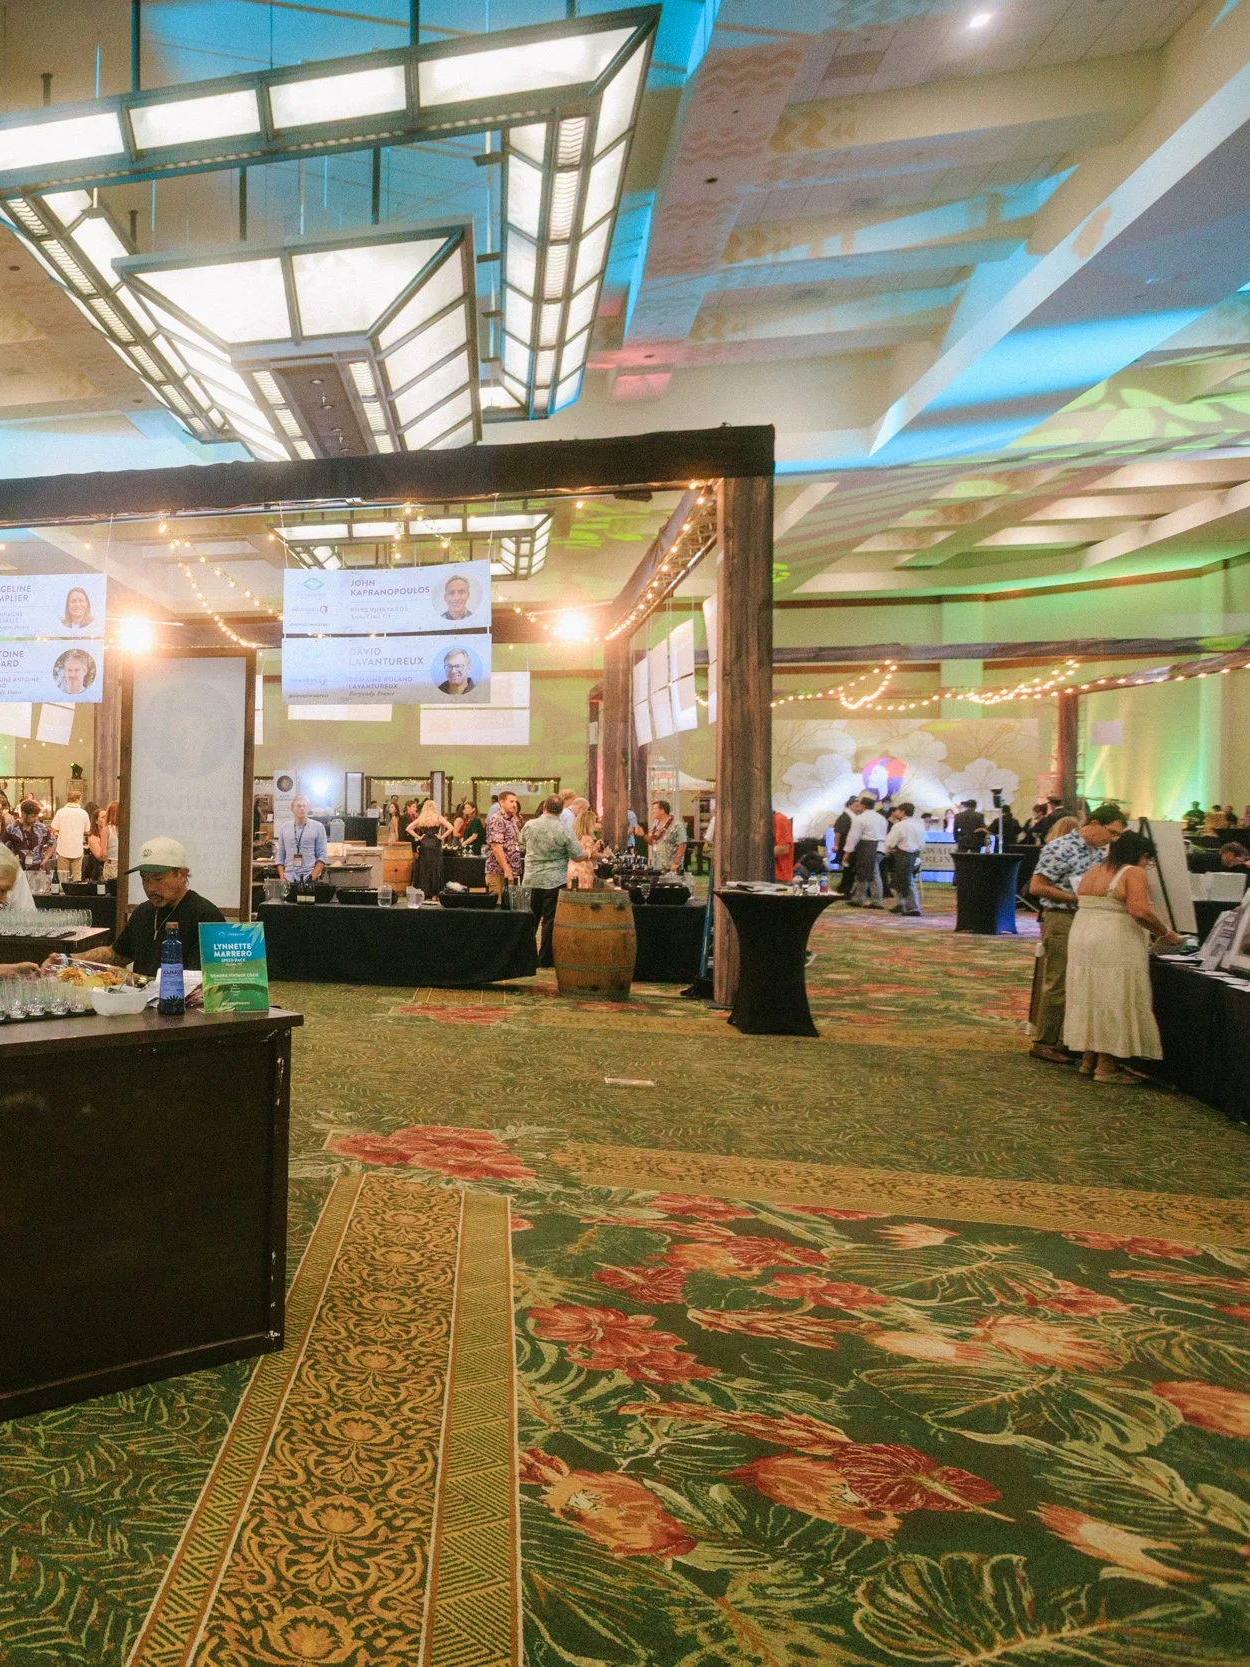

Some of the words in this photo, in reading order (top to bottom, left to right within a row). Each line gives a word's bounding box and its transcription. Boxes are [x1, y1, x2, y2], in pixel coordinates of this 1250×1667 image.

[350, 579, 375, 587] JOHN
[350, 586, 430, 597] KAPRANOPOULOS
[349, 648, 381, 656] DAVID
[349, 657, 424, 665] LAVANTUREUX
[213, 943, 252, 951] LYNNETTE
